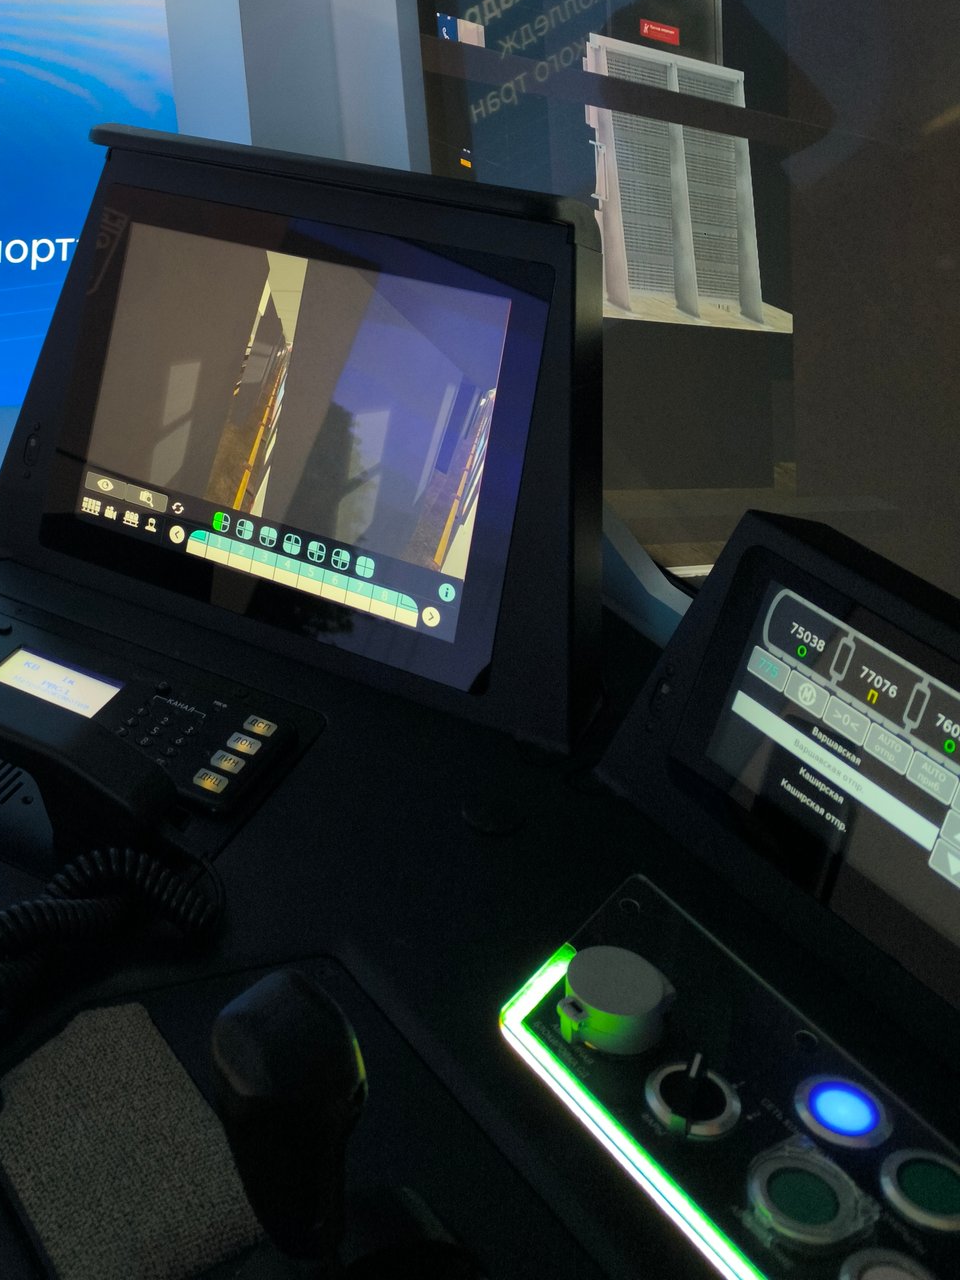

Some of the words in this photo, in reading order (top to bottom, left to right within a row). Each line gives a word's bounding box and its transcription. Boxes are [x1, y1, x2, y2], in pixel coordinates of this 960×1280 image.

[790, 621, 826, 653] 75038
[859, 665, 899, 699] 77076
[166, 697, 196, 713] КАНАЛ
[935, 712, 960, 739] 760
[233, 736, 255, 749] ЛОК
[811, 726, 862, 766] Варшавская
[877, 733, 903, 754] AUTO
[198, 771, 222, 787] ДНЦ
[793, 738, 842, 776] Варшавская
[842, 771, 865, 793] отпр.
[798, 766, 845, 805] Каширская
[780, 777, 825, 817] Каширская
[825, 809, 847, 833] отпр.
